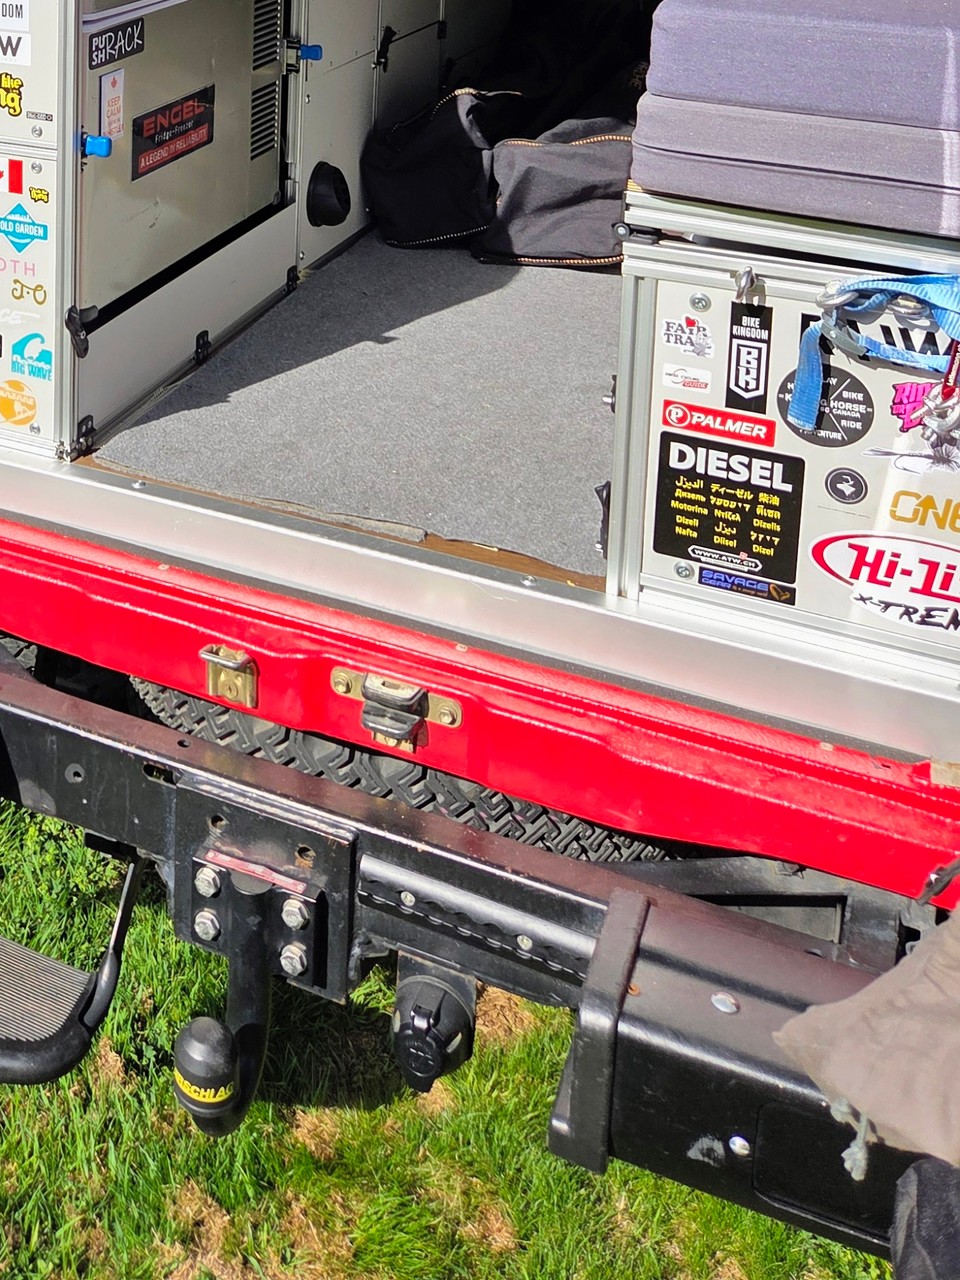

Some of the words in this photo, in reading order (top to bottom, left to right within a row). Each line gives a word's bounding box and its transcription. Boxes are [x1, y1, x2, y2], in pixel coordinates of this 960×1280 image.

[105, 21, 143, 59] RACK
[143, 98, 205, 138] ENGEL
[155, 120, 194, 144] Fridge-Freezer
[146, 145, 169, 166] LEGEND
[176, 128, 208, 151] RELIABILITY
[15, 224, 44, 237] GARDEN
[741, 315, 760, 329] BIKE
[732, 325, 769, 341] KINGDOM
[11, 362, 26, 376] BIG
[28, 365, 52, 381] WAVE
[842, 390, 864, 402] BIKE
[830, 400, 867, 414] HORSE
[832, 408, 861, 419] CANADA
[691, 413, 768, 439] PALMER
[840, 419, 863, 430] RIDE
[668, 441, 793, 493] DIESEL
[675, 475, 704, 490] الديزل
[674, 488, 706, 502] Дизель
[710, 483, 754, 501] ディーゼル
[758, 491, 780, 507] 柴油
[670, 500, 709, 516] Motorina
[675, 526, 699, 539] Nafta
[752, 544, 775, 557] Dizel
[702, 569, 769, 591] SAVAGE
[702, 578, 732, 590] GEAR
